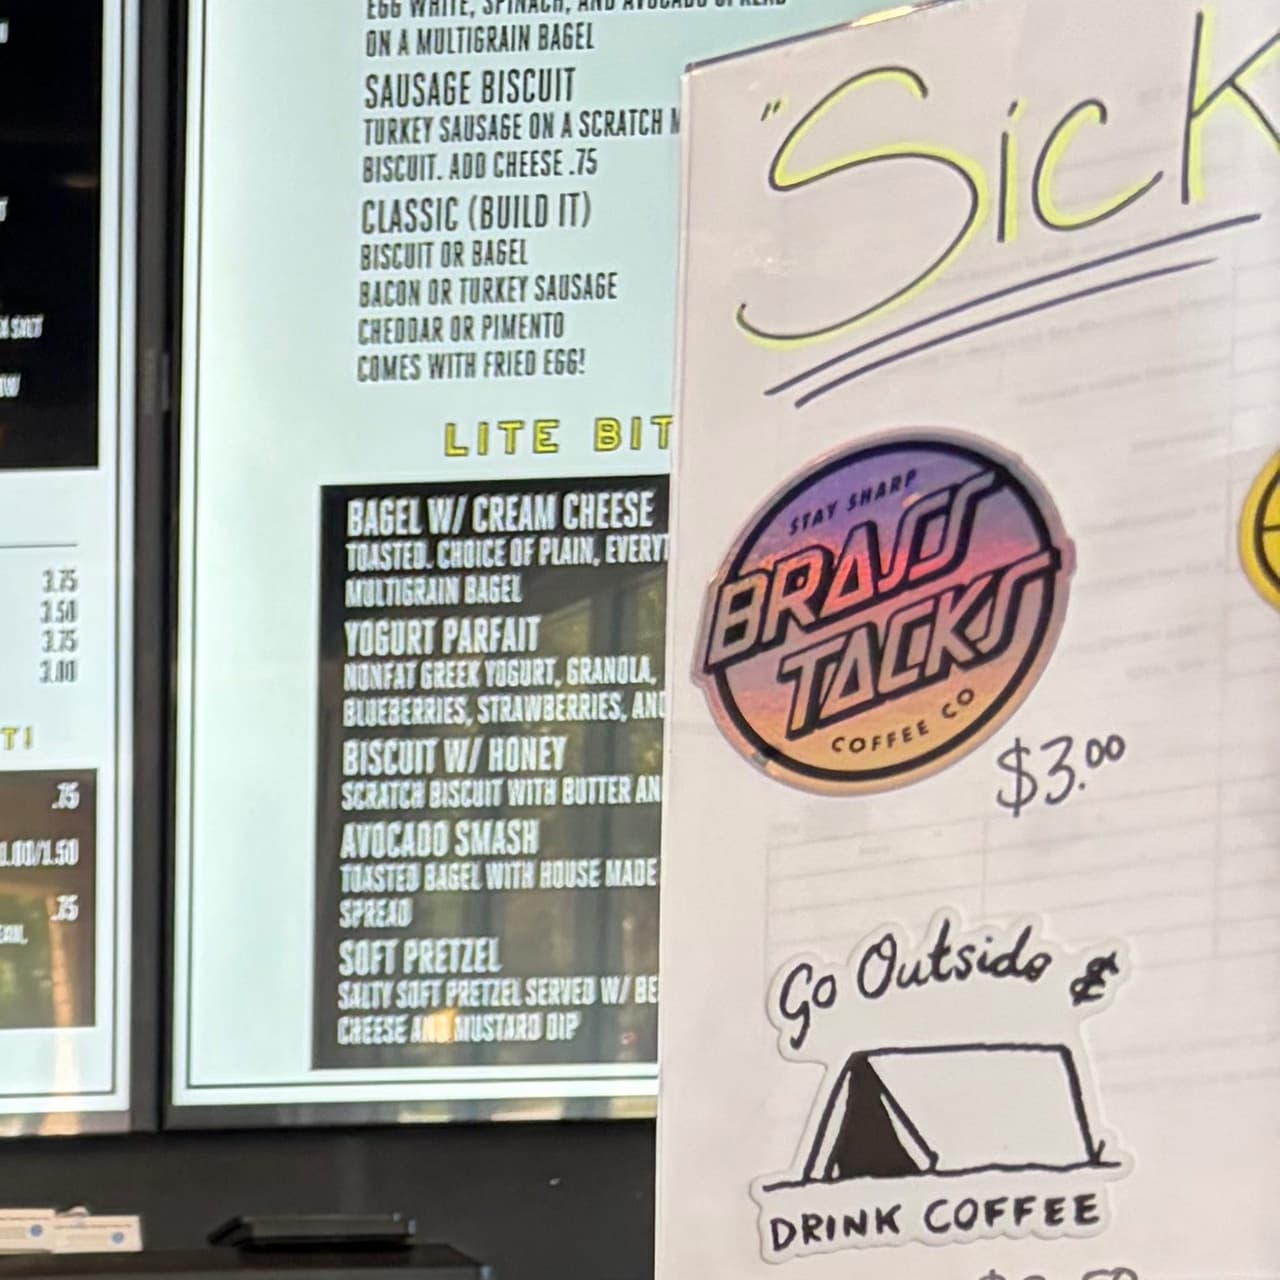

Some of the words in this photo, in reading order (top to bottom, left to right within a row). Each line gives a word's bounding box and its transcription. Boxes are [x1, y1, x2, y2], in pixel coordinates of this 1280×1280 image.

[366, 30, 391, 57] ON
[398, 29, 409, 55] A
[417, 25, 530, 54] MULTIGRAIN
[538, 22, 594, 50] BAGEL
[365, 71, 470, 108] SAUSAGE
[482, 67, 575, 104] BISCUIT
[364, 116, 433, 145] TURKEY
[440, 113, 522, 142] SAUSAGE
[529, 112, 554, 139] ON
[561, 112, 572, 138] A
[579, 108, 662, 137] SCRATCH
[363, 154, 442, 183] BISCUIT.
[449, 152, 486, 180] ADD
[494, 149, 562, 178] CHEESE
[569, 148, 597, 175] .75
[362, 196, 458, 234] CLASSIC
[469, 194, 548, 230] (BUILD
[559, 191, 591, 227] IT)
[361, 242, 434, 271] BISCUIT
[441, 241, 464, 268] OR
[472, 238, 527, 266] BAGEL
[360, 280, 420, 307] BACON
[429, 278, 451, 305] OR
[459, 276, 528, 304] TURKEY
[535, 272, 618, 301] SAUSAGE
[358, 316, 443, 345] CHEDDAR
[451, 315, 473, 342] OR
[482, 312, 564, 340] PIMENTO
[358, 354, 421, 382] COMES
[428, 352, 476, 379] WITH
[484, 350, 536, 377] FRIED
[544, 348, 585, 375] EGG!
[444, 419, 560, 457] LITE
[348, 498, 422, 536] BAGEL
[428, 496, 466, 534] W/
[473, 494, 556, 532] CREAM
[563, 491, 654, 529] CHEESE
[789, 501, 836, 536] STAY
[846, 468, 918, 512] SHARP
[437, 538, 506, 569] CHOICE
[510, 537, 535, 566] OF
[539, 536, 600, 566] PLAIN,
[706, 467, 1005, 667] BRASS
[346, 576, 459, 607] MULTIGRAIN
[465, 574, 522, 604] BAGEL
[345, 618, 437, 656] YOGURT
[443, 616, 541, 653] PARFAIT
[778, 549, 1057, 741] TACKS
[344, 660, 416, 691] NONFAT
[421, 660, 480, 689] GREEK
[485, 657, 562, 687] YOGURT,
[567, 656, 656, 685] GRANOLA,
[343, 695, 473, 727] BLUEBERRIES,
[477, 692, 627, 723] STRAWBERRIES,
[832, 720, 930, 753] COFFEE
[942, 688, 974, 719] CO
[343, 738, 438, 775] BISCUIT
[444, 737, 483, 773] W/
[489, 736, 568, 771] HONEY
[342, 780, 425, 810] SCRATCH
[430, 778, 503, 808] BISCUIT
[508, 778, 557, 806] WITH
[562, 776, 631, 805] BUTTER
[996, 734, 1126, 818] $3.00
[341, 822, 449, 858] AVOCADO
[455, 819, 539, 856] SMASH
[340, 864, 419, 892] TOASTED
[425, 862, 481, 891] BAGEL
[486, 861, 535, 889] WITH
[540, 859, 600, 888] HOUSE
[606, 858, 657, 886] MADE
[340, 898, 412, 928] SPREAD
[339, 939, 398, 976] SOFT
[404, 937, 502, 973] PRETZEL
[338, 981, 394, 1009] SALTY
[396, 980, 442, 1008] SOFT
[446, 978, 522, 1007] PRETZEL
[525, 977, 595, 1005] SERVED
[599, 975, 631, 1004] W/
[778, 963, 836, 1049] Go
[857, 919, 1051, 999] Outside
[338, 1014, 408, 1044] CHEESE
[454, 1012, 541, 1041] MUSTARD
[546, 1012, 580, 1040] DIP
[770, 1203, 903, 1251] DRINK
[923, 1193, 1100, 1231] COFFEE
